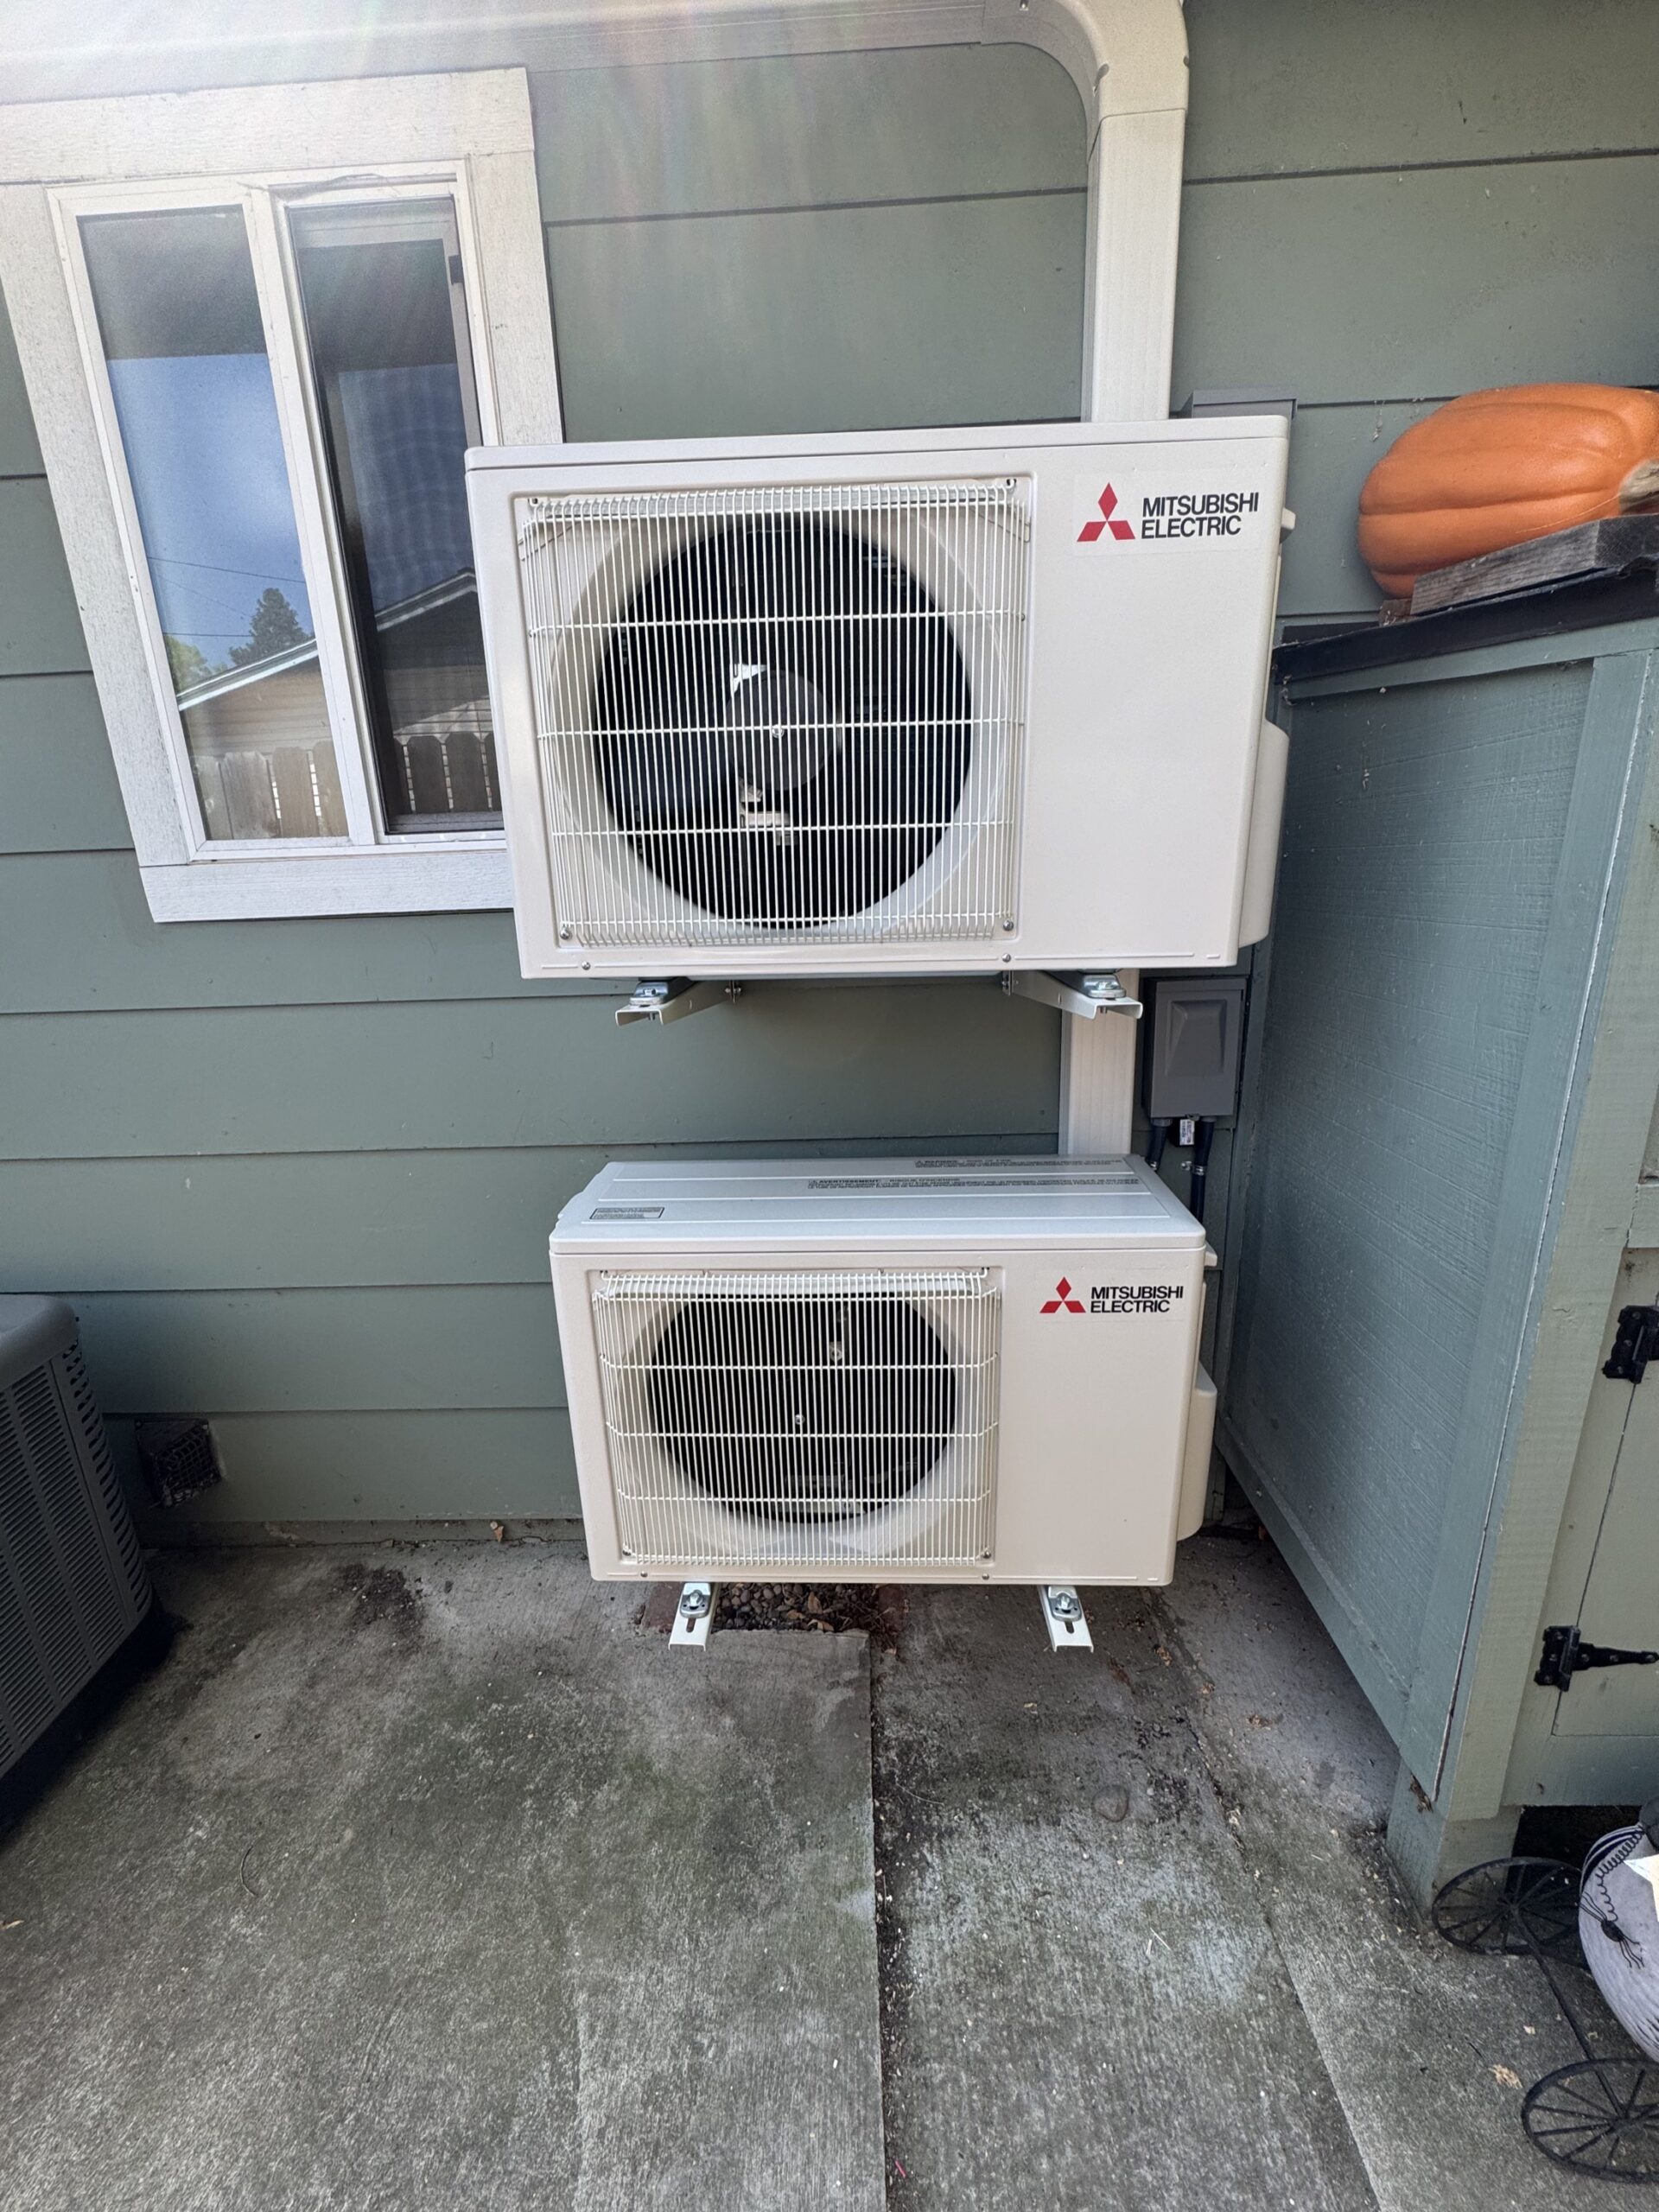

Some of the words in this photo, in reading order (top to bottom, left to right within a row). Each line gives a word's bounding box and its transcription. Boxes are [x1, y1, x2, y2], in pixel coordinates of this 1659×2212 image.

[1142, 492, 1259, 517] MITSUBISHI
[1141, 515, 1242, 539] ELECTRIC
[1090, 1286, 1184, 1299] MITSUBISHI
[1090, 1300, 1170, 1313] ELECTRIC
